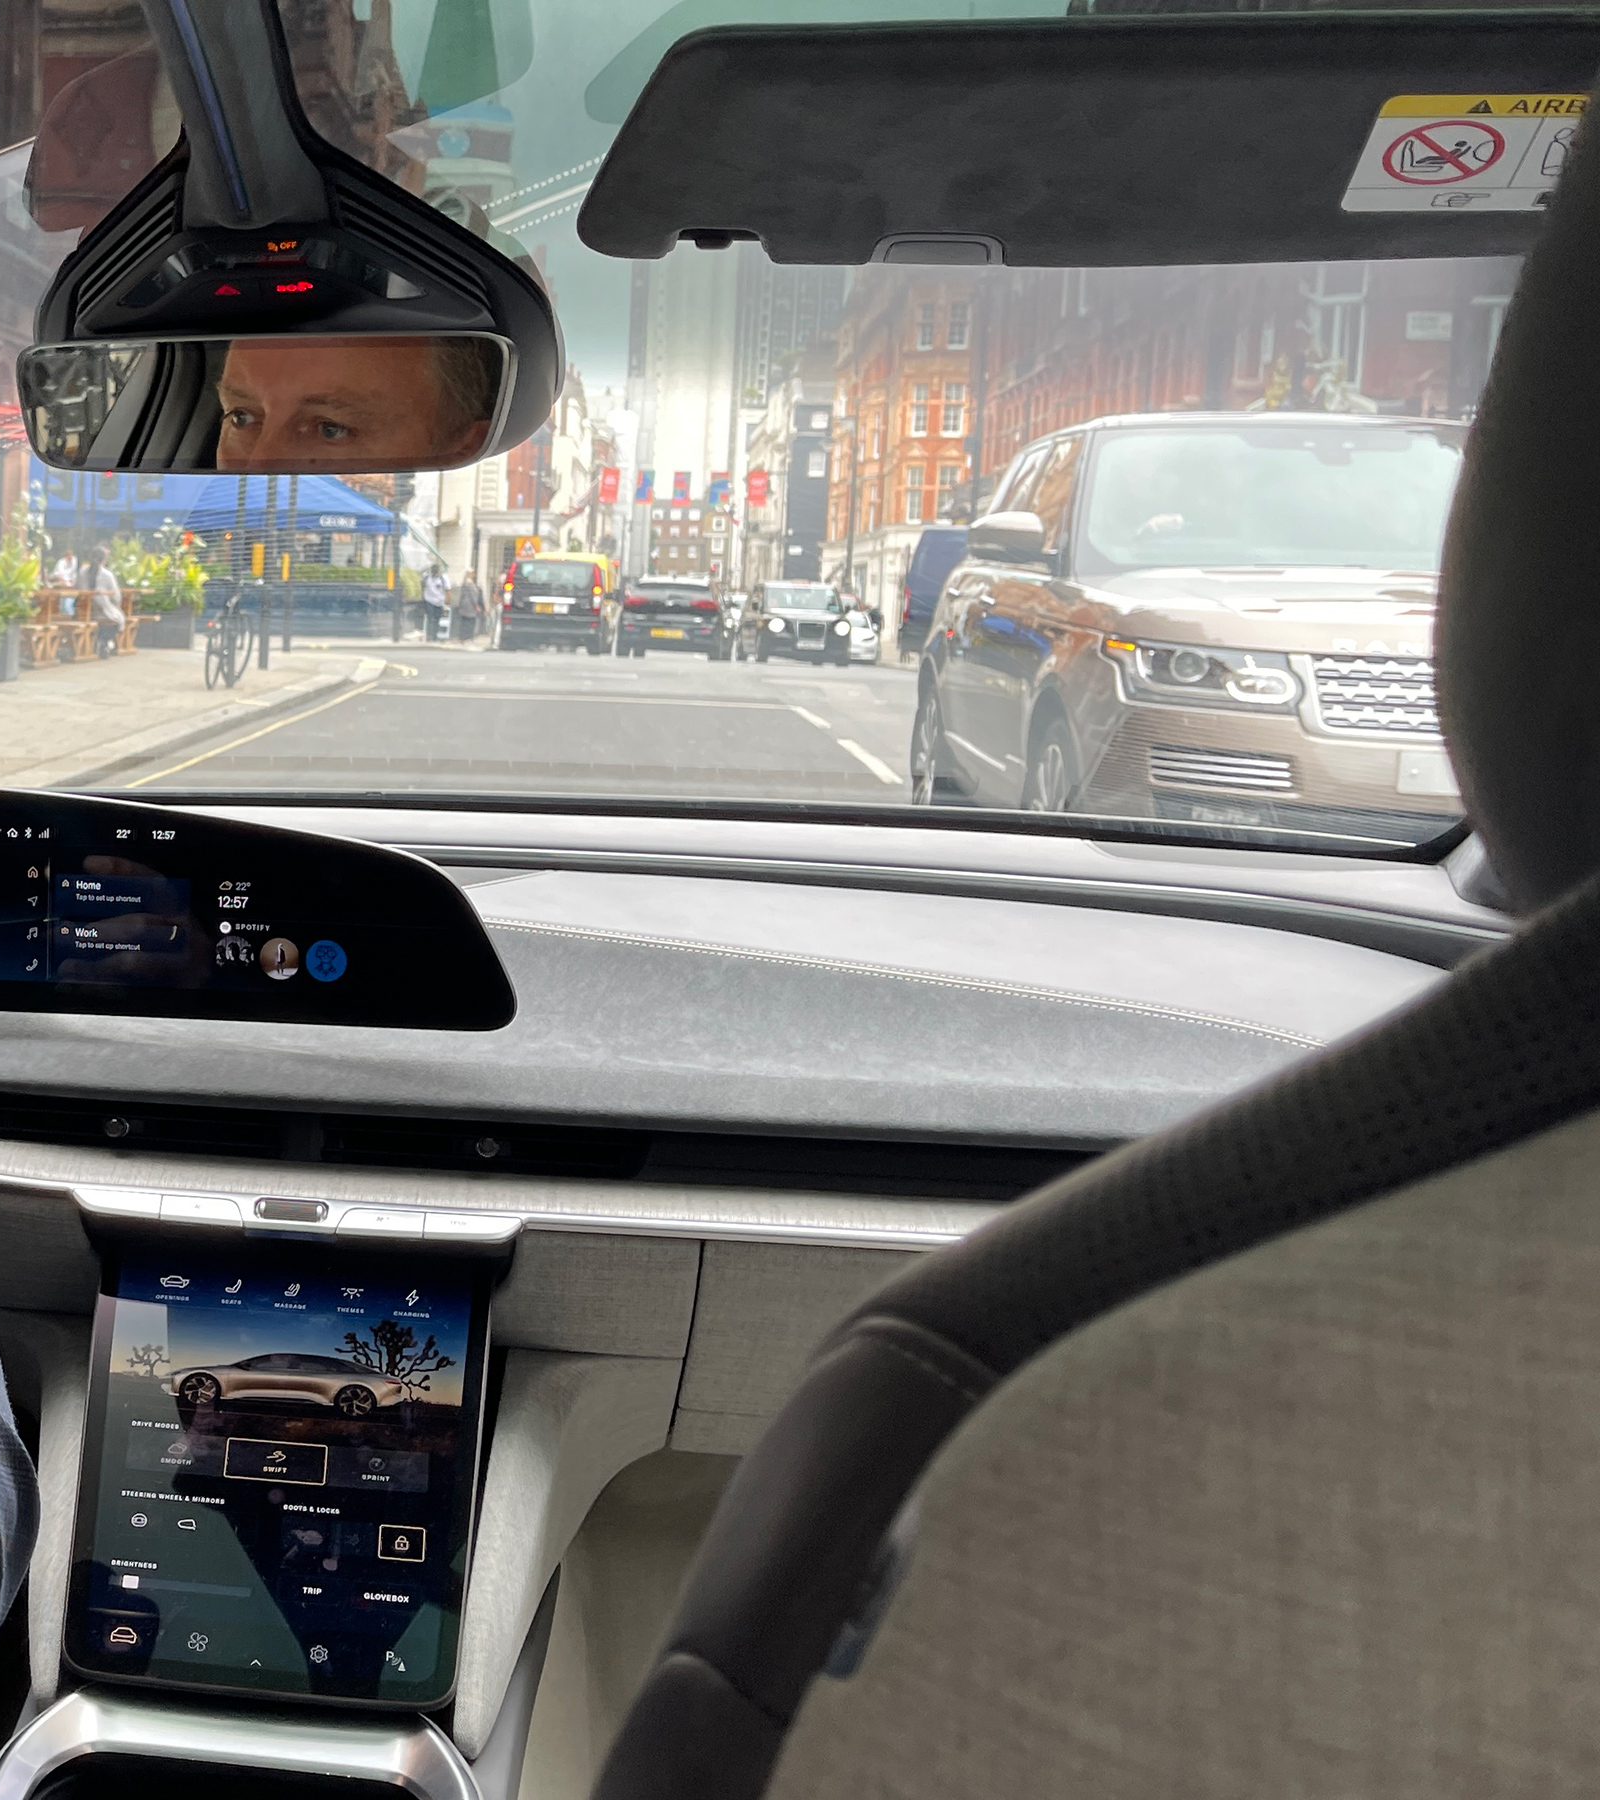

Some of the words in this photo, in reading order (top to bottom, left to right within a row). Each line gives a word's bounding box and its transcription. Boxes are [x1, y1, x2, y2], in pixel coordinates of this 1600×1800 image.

[1506, 98, 1587, 114] AIRB
[279, 241, 297, 250] OFF
[151, 829, 176, 841] 12:57
[75, 879, 102, 891] Home
[75, 893, 87, 902] Tap
[95, 894, 106, 902] set
[106, 895, 115, 903] up
[115, 895, 142, 903] shortcut
[217, 895, 249, 909] 12:57
[74, 927, 98, 938] Work
[235, 923, 270, 932] SPOTIFY
[74, 940, 87, 949] Tap
[87, 941, 95, 949] to
[114, 942, 141, 951] shortcut
[154, 1293, 191, 1302] OPENINGS
[220, 1298, 242, 1306] SEATS
[273, 1301, 307, 1310] MASSAGE
[336, 1306, 366, 1315] THEMES
[392, 1309, 431, 1319] CHARGING
[131, 1420, 153, 1428] DRIVE
[154, 1421, 180, 1430] MODES
[160, 1457, 192, 1466] SMOOTH
[262, 1465, 288, 1474] SWIFT
[361, 1473, 391, 1482] SPRINT
[121, 1489, 157, 1499] STEERING
[158, 1493, 183, 1502] WHEEL
[191, 1496, 225, 1505] MIRRORS
[309, 1505, 315, 1513] &
[316, 1506, 341, 1515] LOCKS
[110, 1559, 158, 1570] BRIGHTNESS
[302, 1586, 323, 1596] TRIP
[363, 1592, 410, 1604] GLOVEBOX
